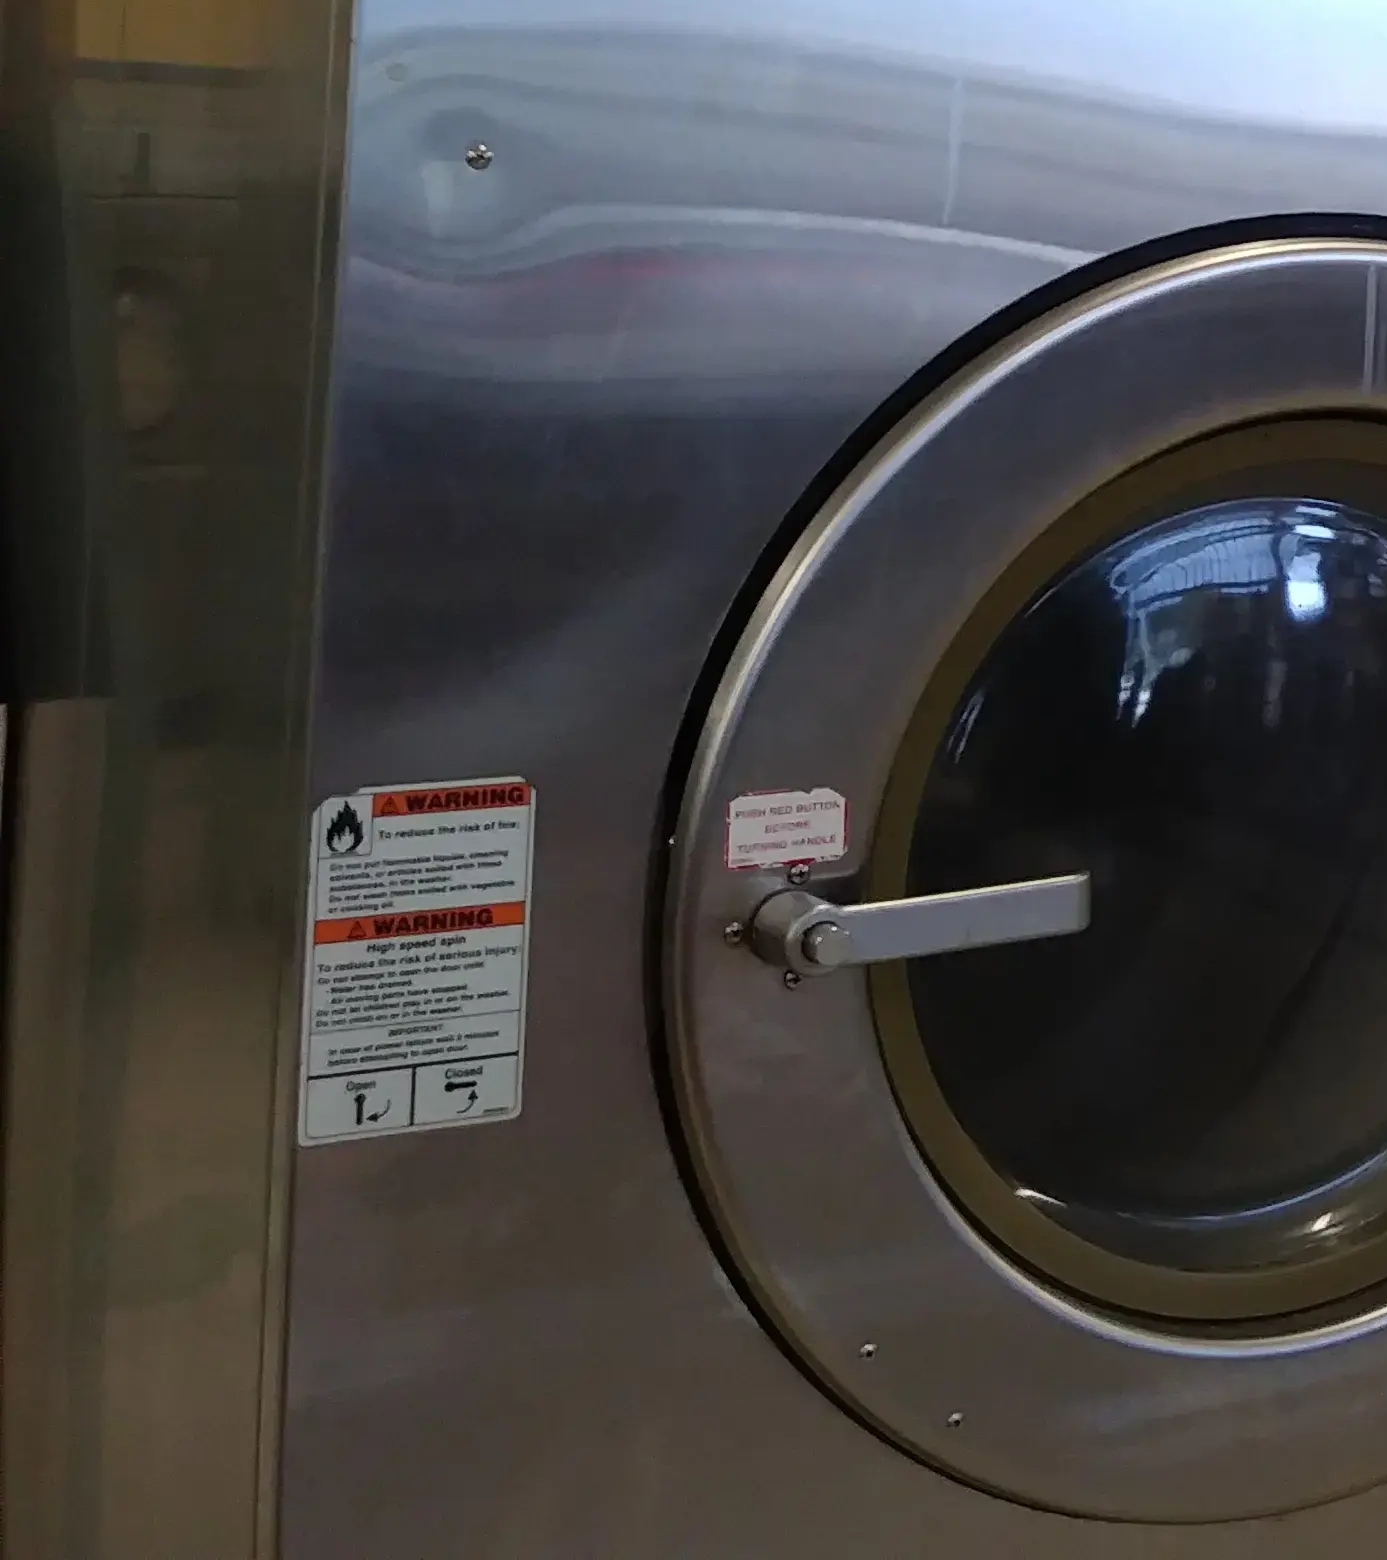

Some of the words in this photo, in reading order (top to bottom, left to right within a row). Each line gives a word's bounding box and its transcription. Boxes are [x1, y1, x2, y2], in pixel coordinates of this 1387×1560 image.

[405, 786, 525, 813] WARNING
[796, 800, 840, 813] BUTTON
[380, 829, 391, 839] To
[395, 827, 434, 838] reduce
[438, 826, 455, 834] the
[460, 824, 480, 832] risk
[484, 821, 495, 831] of
[373, 908, 493, 936] WARNING
[367, 942, 395, 954] High
[400, 937, 436, 951] speed
[440, 935, 466, 947] spin
[318, 964, 331, 972] To
[334, 960, 374, 971] reduce
[378, 958, 396, 966] the
[400, 955, 420, 964] risk
[425, 952, 435, 962] of
[439, 949, 481, 959] serious
[445, 1065, 483, 1079] Closed
[346, 1080, 377, 1092] Open
